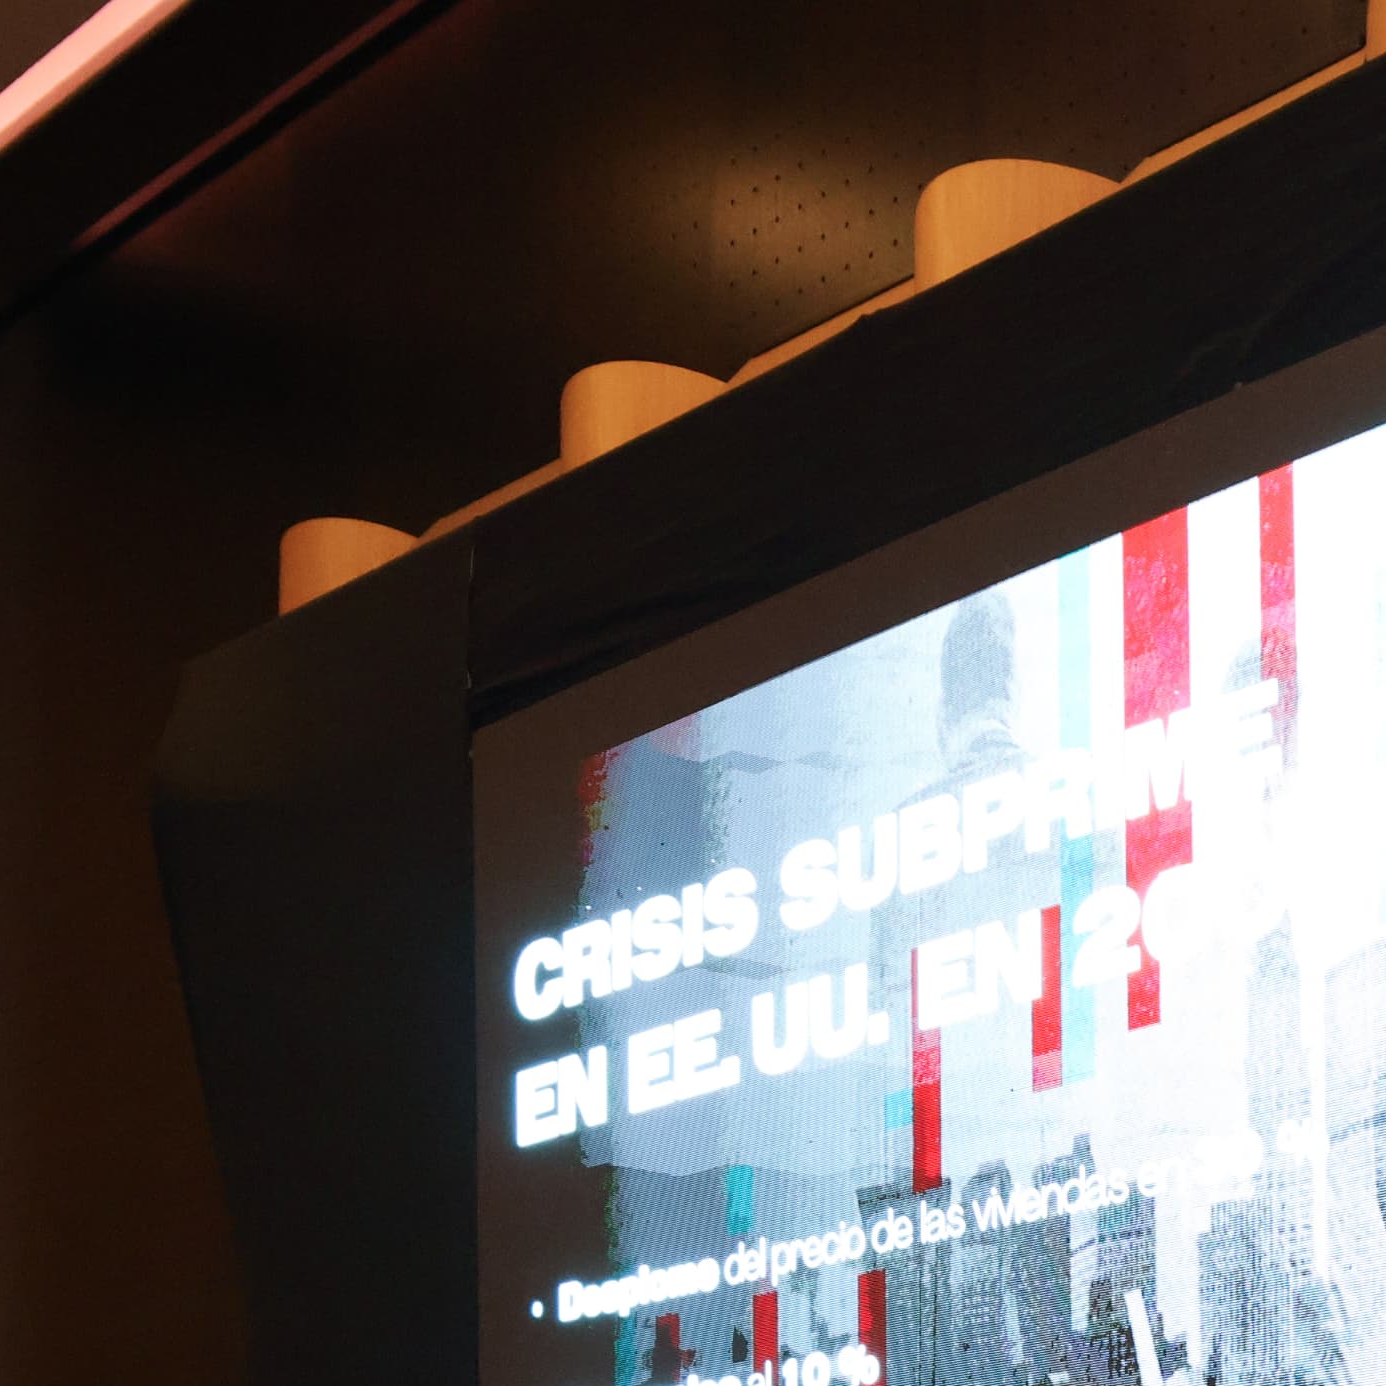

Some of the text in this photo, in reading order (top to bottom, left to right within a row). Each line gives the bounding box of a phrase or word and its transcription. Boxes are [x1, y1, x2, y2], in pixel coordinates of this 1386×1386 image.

[515, 677, 1282, 1022] CRISIS SUBPRIME
[515, 1044, 608, 1148] EN
[628, 1006, 742, 1117] EE.
[752, 963, 890, 1077] UU.
[916, 907, 1043, 1032] EN
[558, 1256, 720, 1323] Desplome
[724, 1236, 765, 1284] del
[772, 1220, 865, 1288] precio
[871, 1207, 913, 1254] de
[920, 1200, 966, 1244] las
[973, 1164, 1130, 1231] viviendas
[838, 1343, 881, 1386] %
